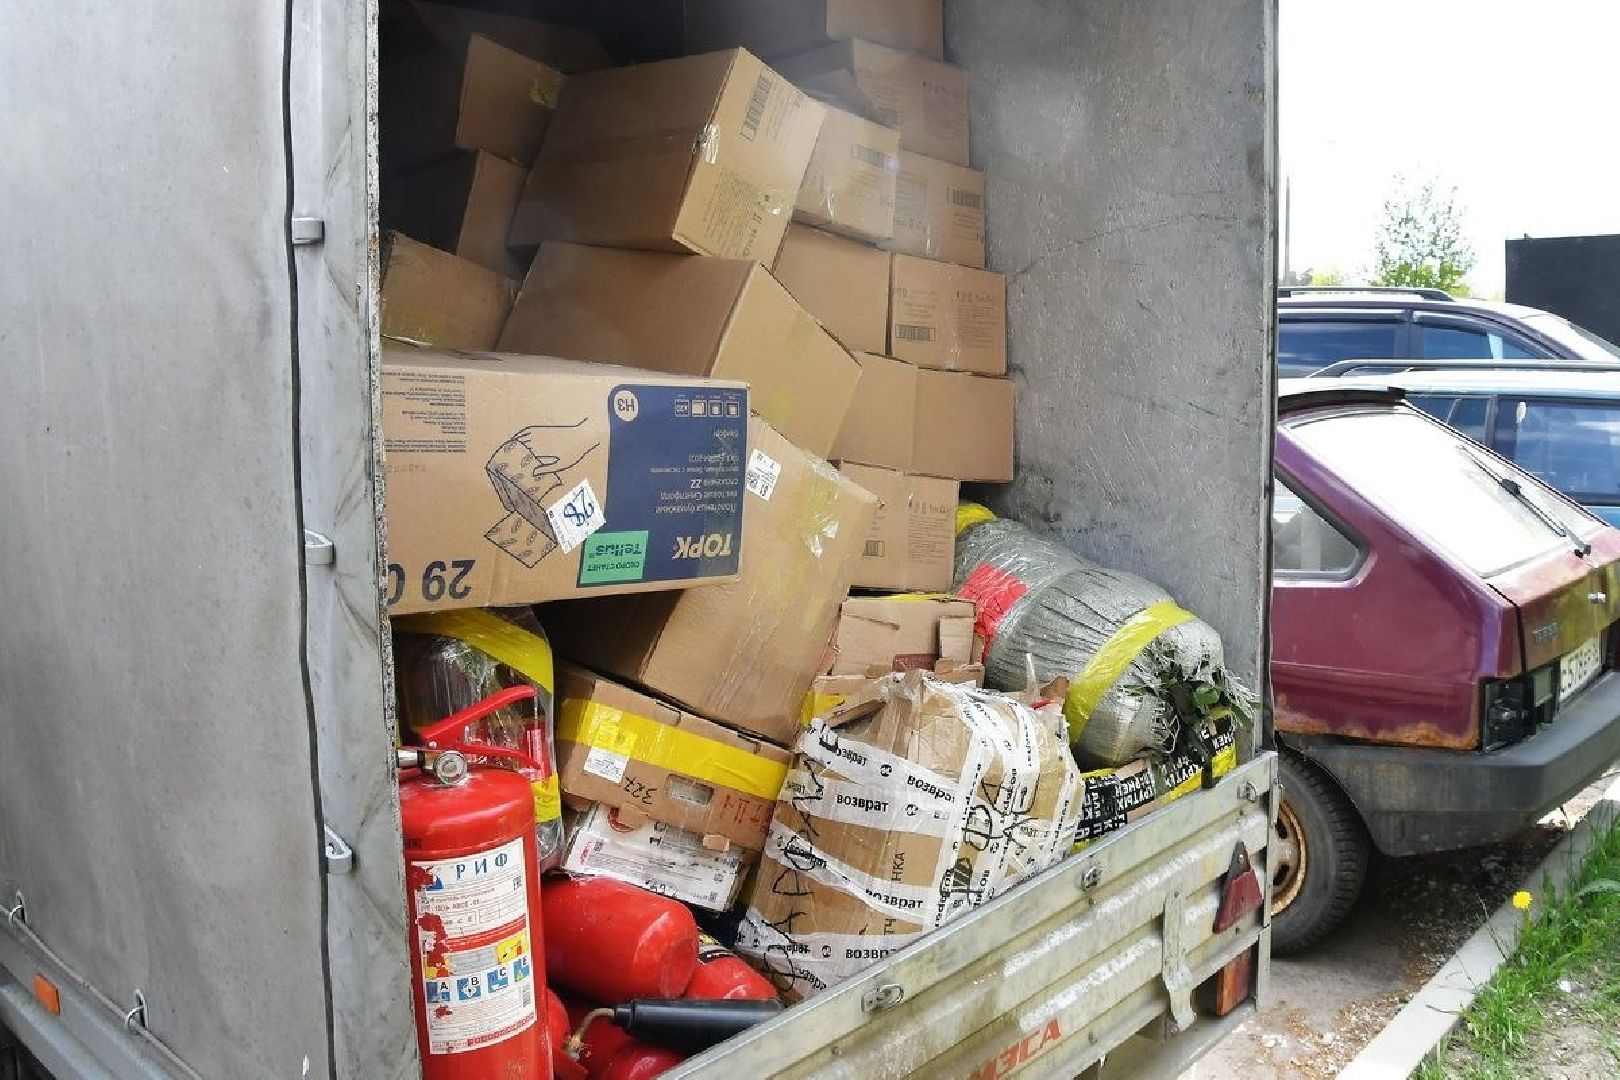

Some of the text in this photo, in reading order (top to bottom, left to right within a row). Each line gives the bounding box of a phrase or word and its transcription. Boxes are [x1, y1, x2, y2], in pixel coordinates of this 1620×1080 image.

[422, 559, 476, 603] 29
[833, 748, 868, 767] озврат
[836, 794, 889, 813] возврат
[455, 852, 508, 879] РИФ
